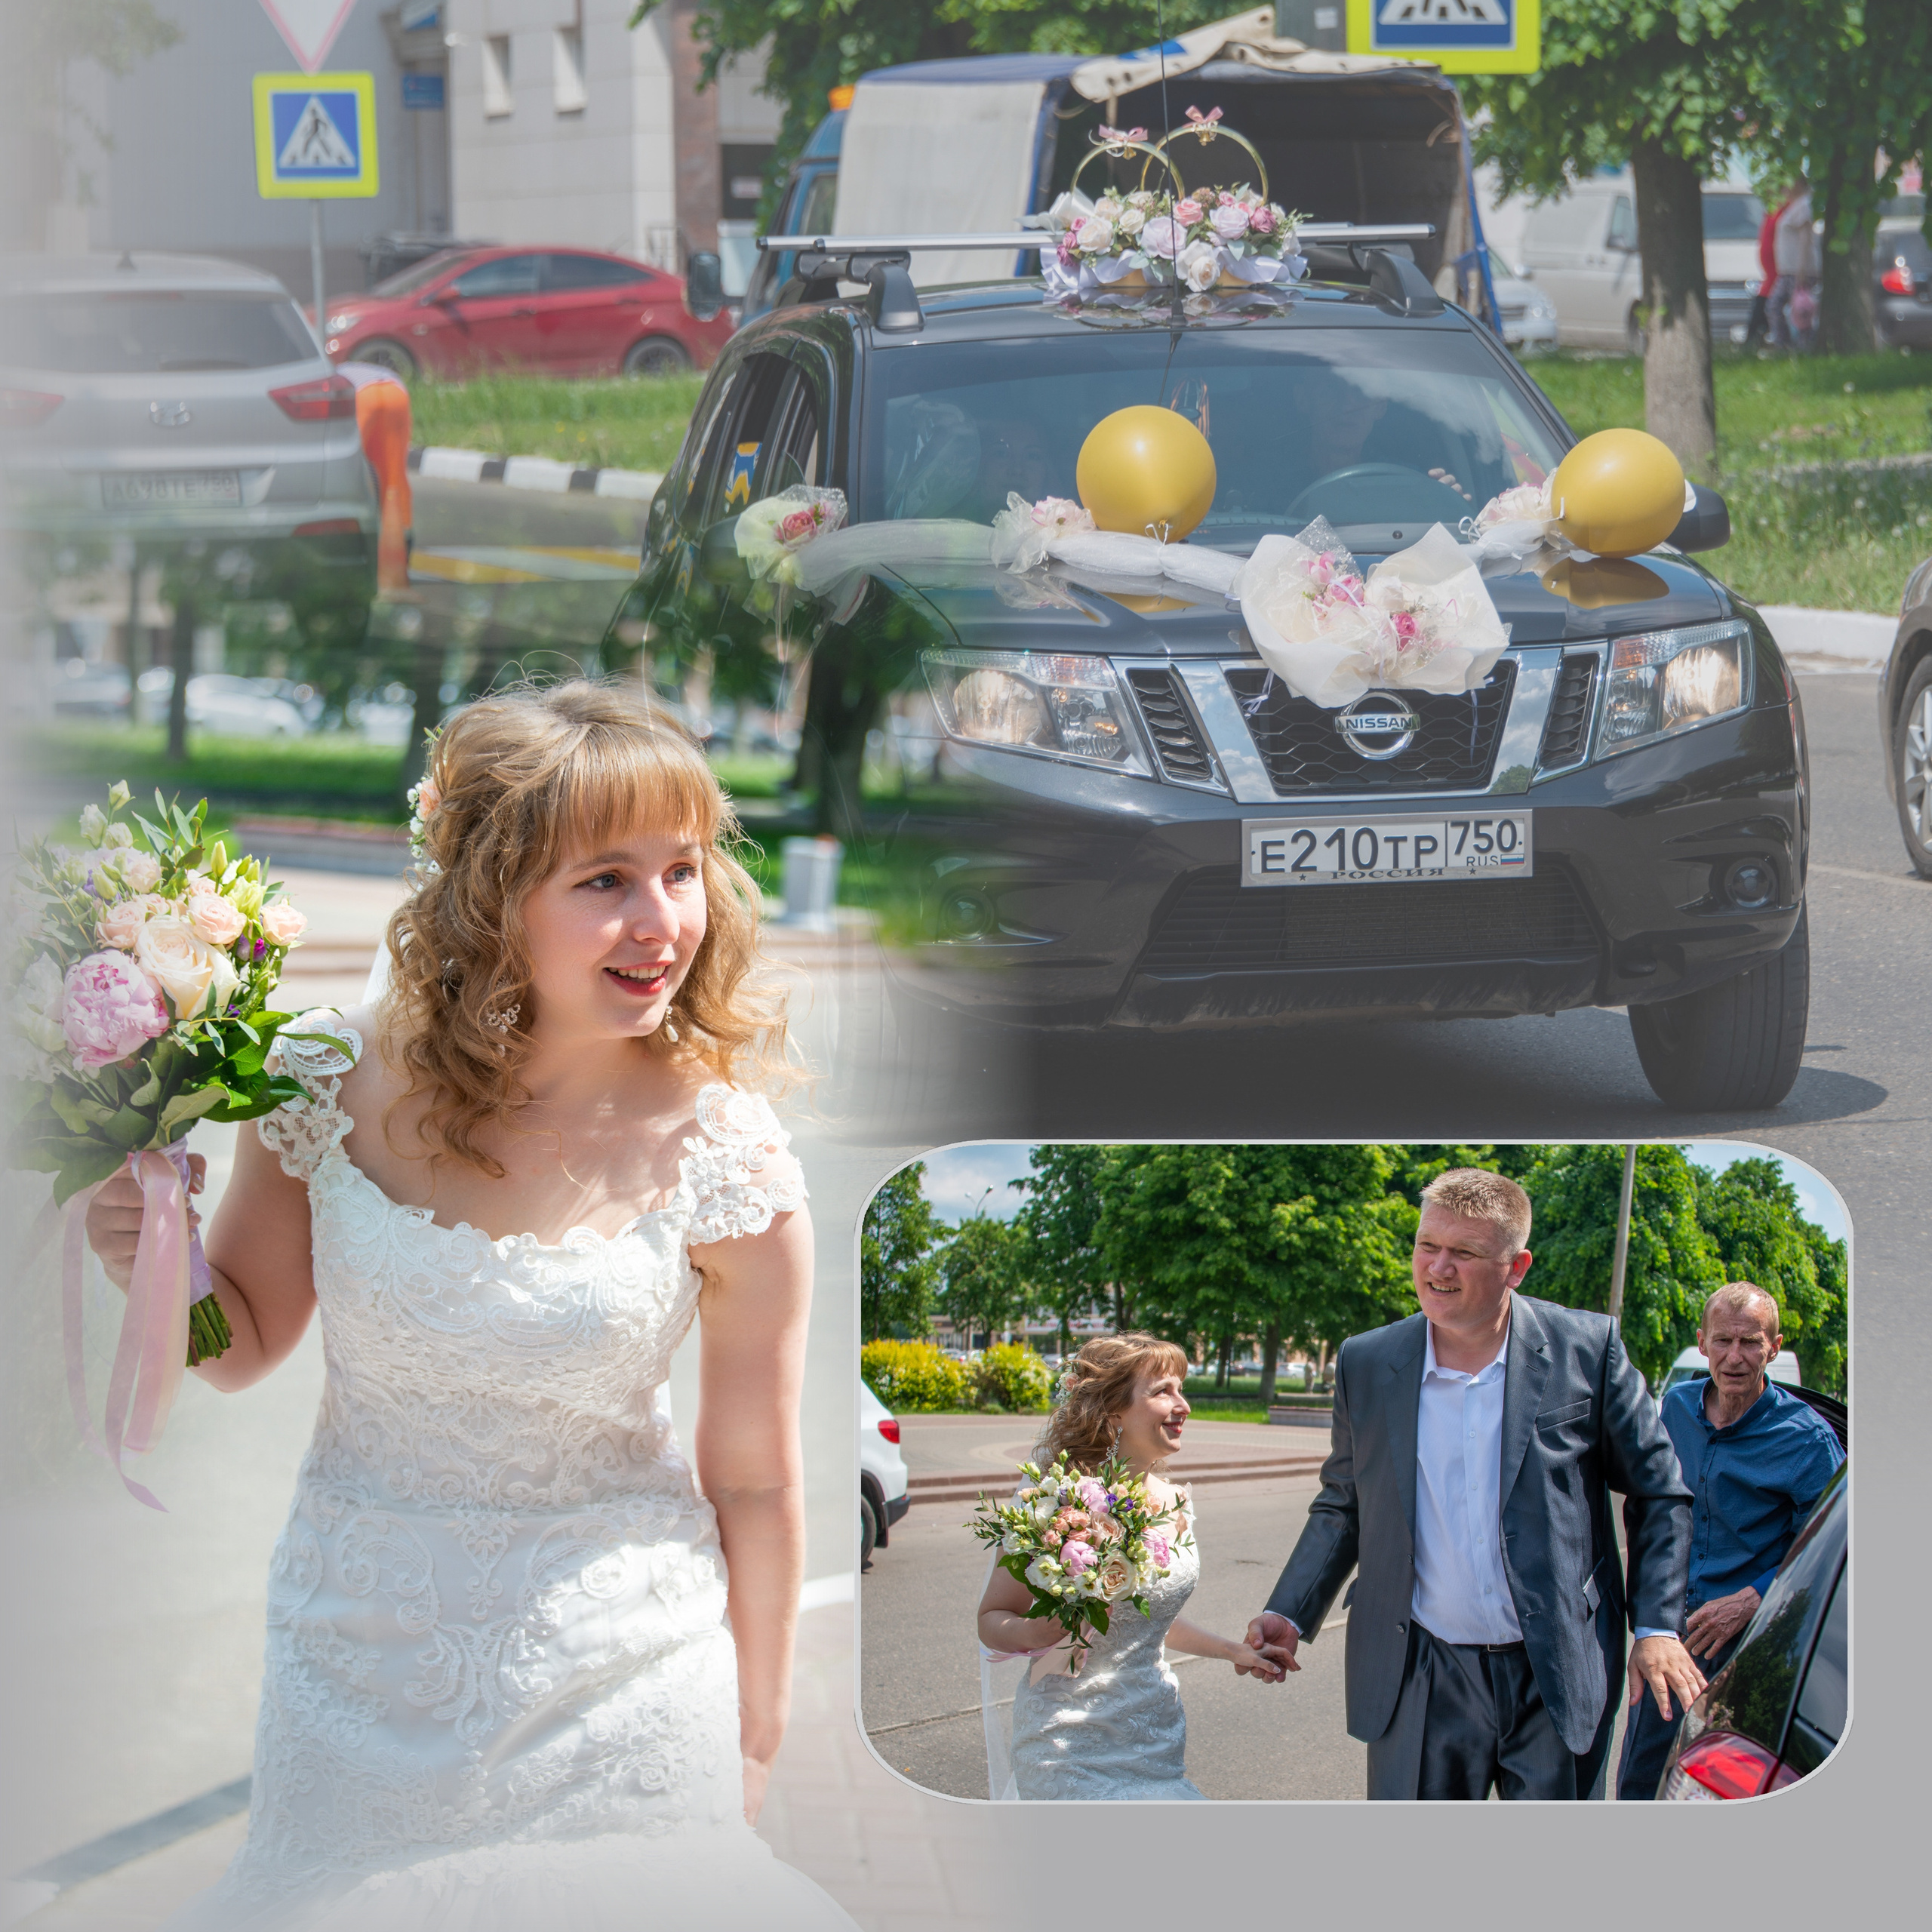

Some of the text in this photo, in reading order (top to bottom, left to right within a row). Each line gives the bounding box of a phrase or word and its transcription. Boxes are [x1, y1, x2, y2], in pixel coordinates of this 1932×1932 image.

[1346, 717, 1412, 729] NISSAN
[1451, 819, 1518, 855] 750
[1466, 855, 1499, 866] RUS
[1331, 868, 1444, 880] РОССИЯ
